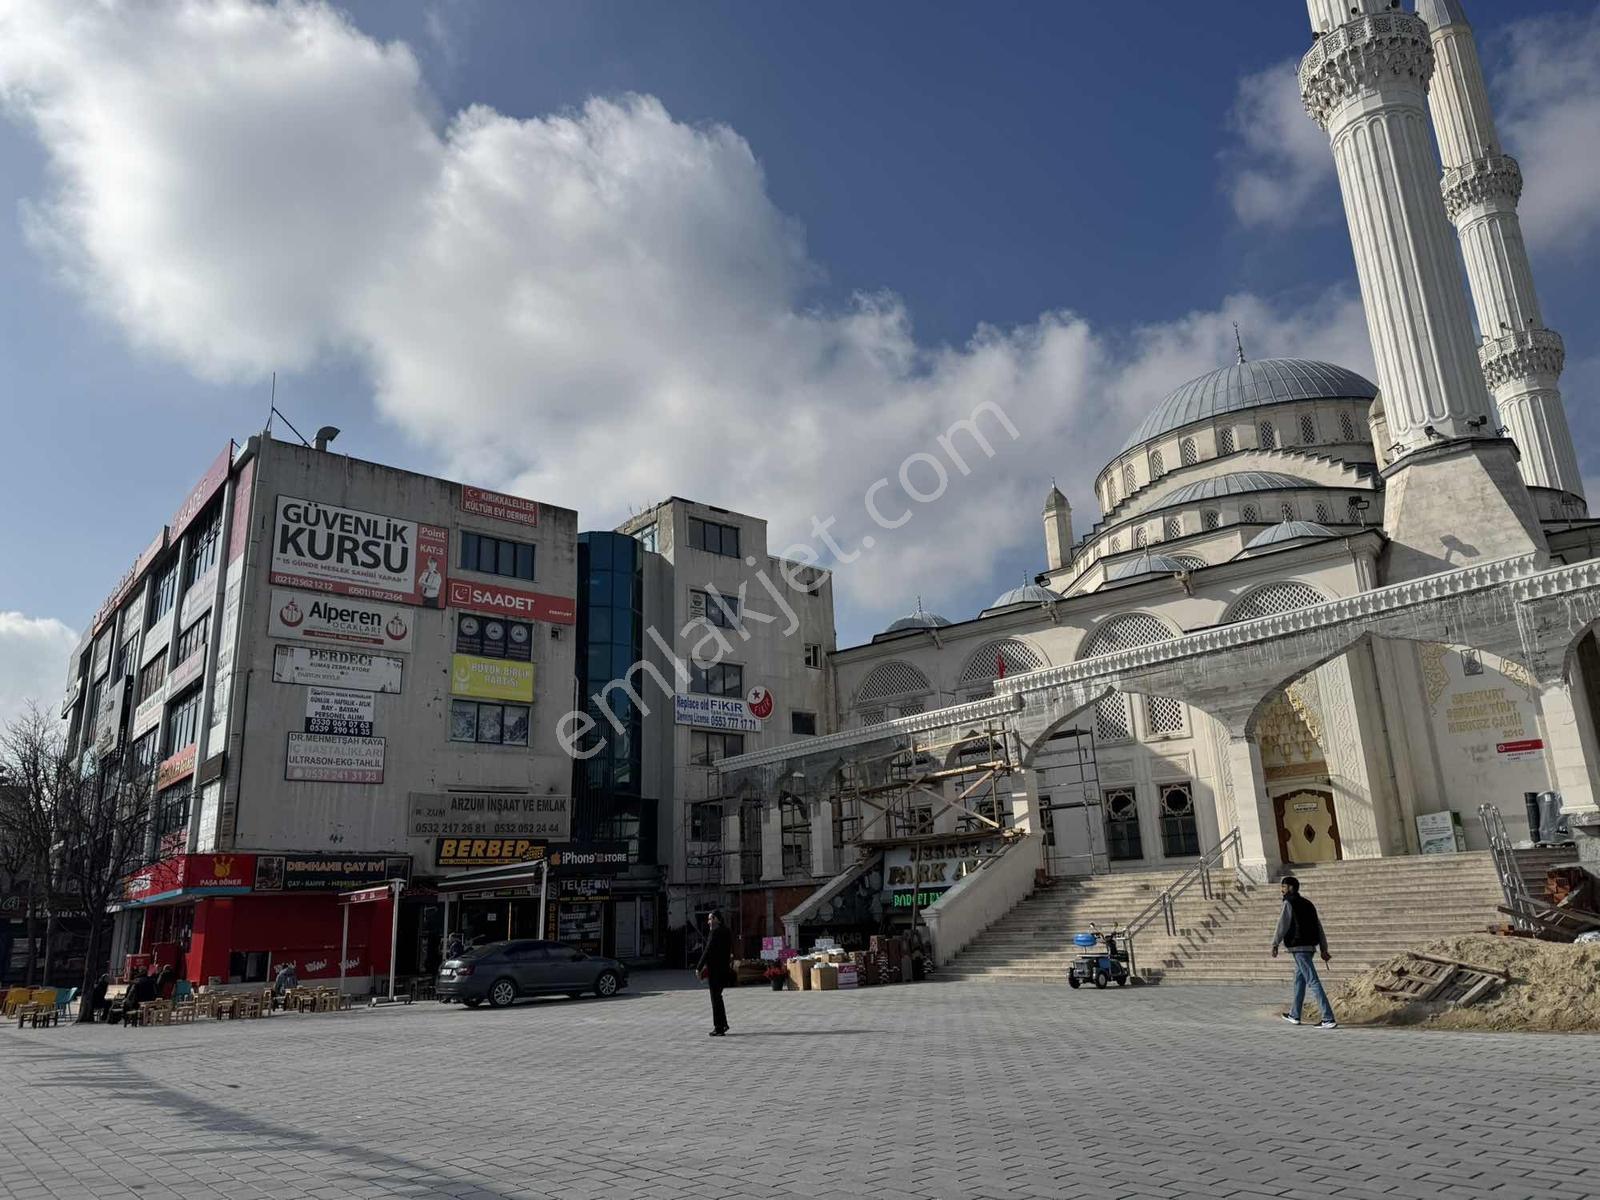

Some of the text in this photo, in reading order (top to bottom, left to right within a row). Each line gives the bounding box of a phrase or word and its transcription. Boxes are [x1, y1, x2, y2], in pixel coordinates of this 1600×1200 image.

[465, 501, 493, 515] KÜLTÜR
[494, 506, 506, 516] EVİ
[282, 502, 408, 544] GÜVENLİK
[421, 528, 446, 539] Point
[279, 524, 408, 574] KURSU
[473, 590, 535, 611] SAADET
[309, 601, 382, 627] Alperen
[676, 696, 710, 711] Replace old
[314, 711, 346, 720] PERSONEL
[309, 725, 330, 733] 0539
[362, 738, 383, 746] KAYA
[450, 795, 567, 814] ARZUM İNŞAAT VE EMLAK
[416, 823, 439, 833] 0532
[442, 823, 459, 833] 217
[475, 824, 486, 833] 81
[494, 823, 516, 833] 0532
[536, 824, 547, 833] 24
[549, 824, 559, 833] 44
[440, 839, 529, 858] BERBER
[562, 852, 595, 864] iPhone
[604, 853, 627, 863] STORE
[343, 860, 366, 874] ÇAY
[368, 859, 385, 872] EVİ
[887, 862, 947, 885] PARK
